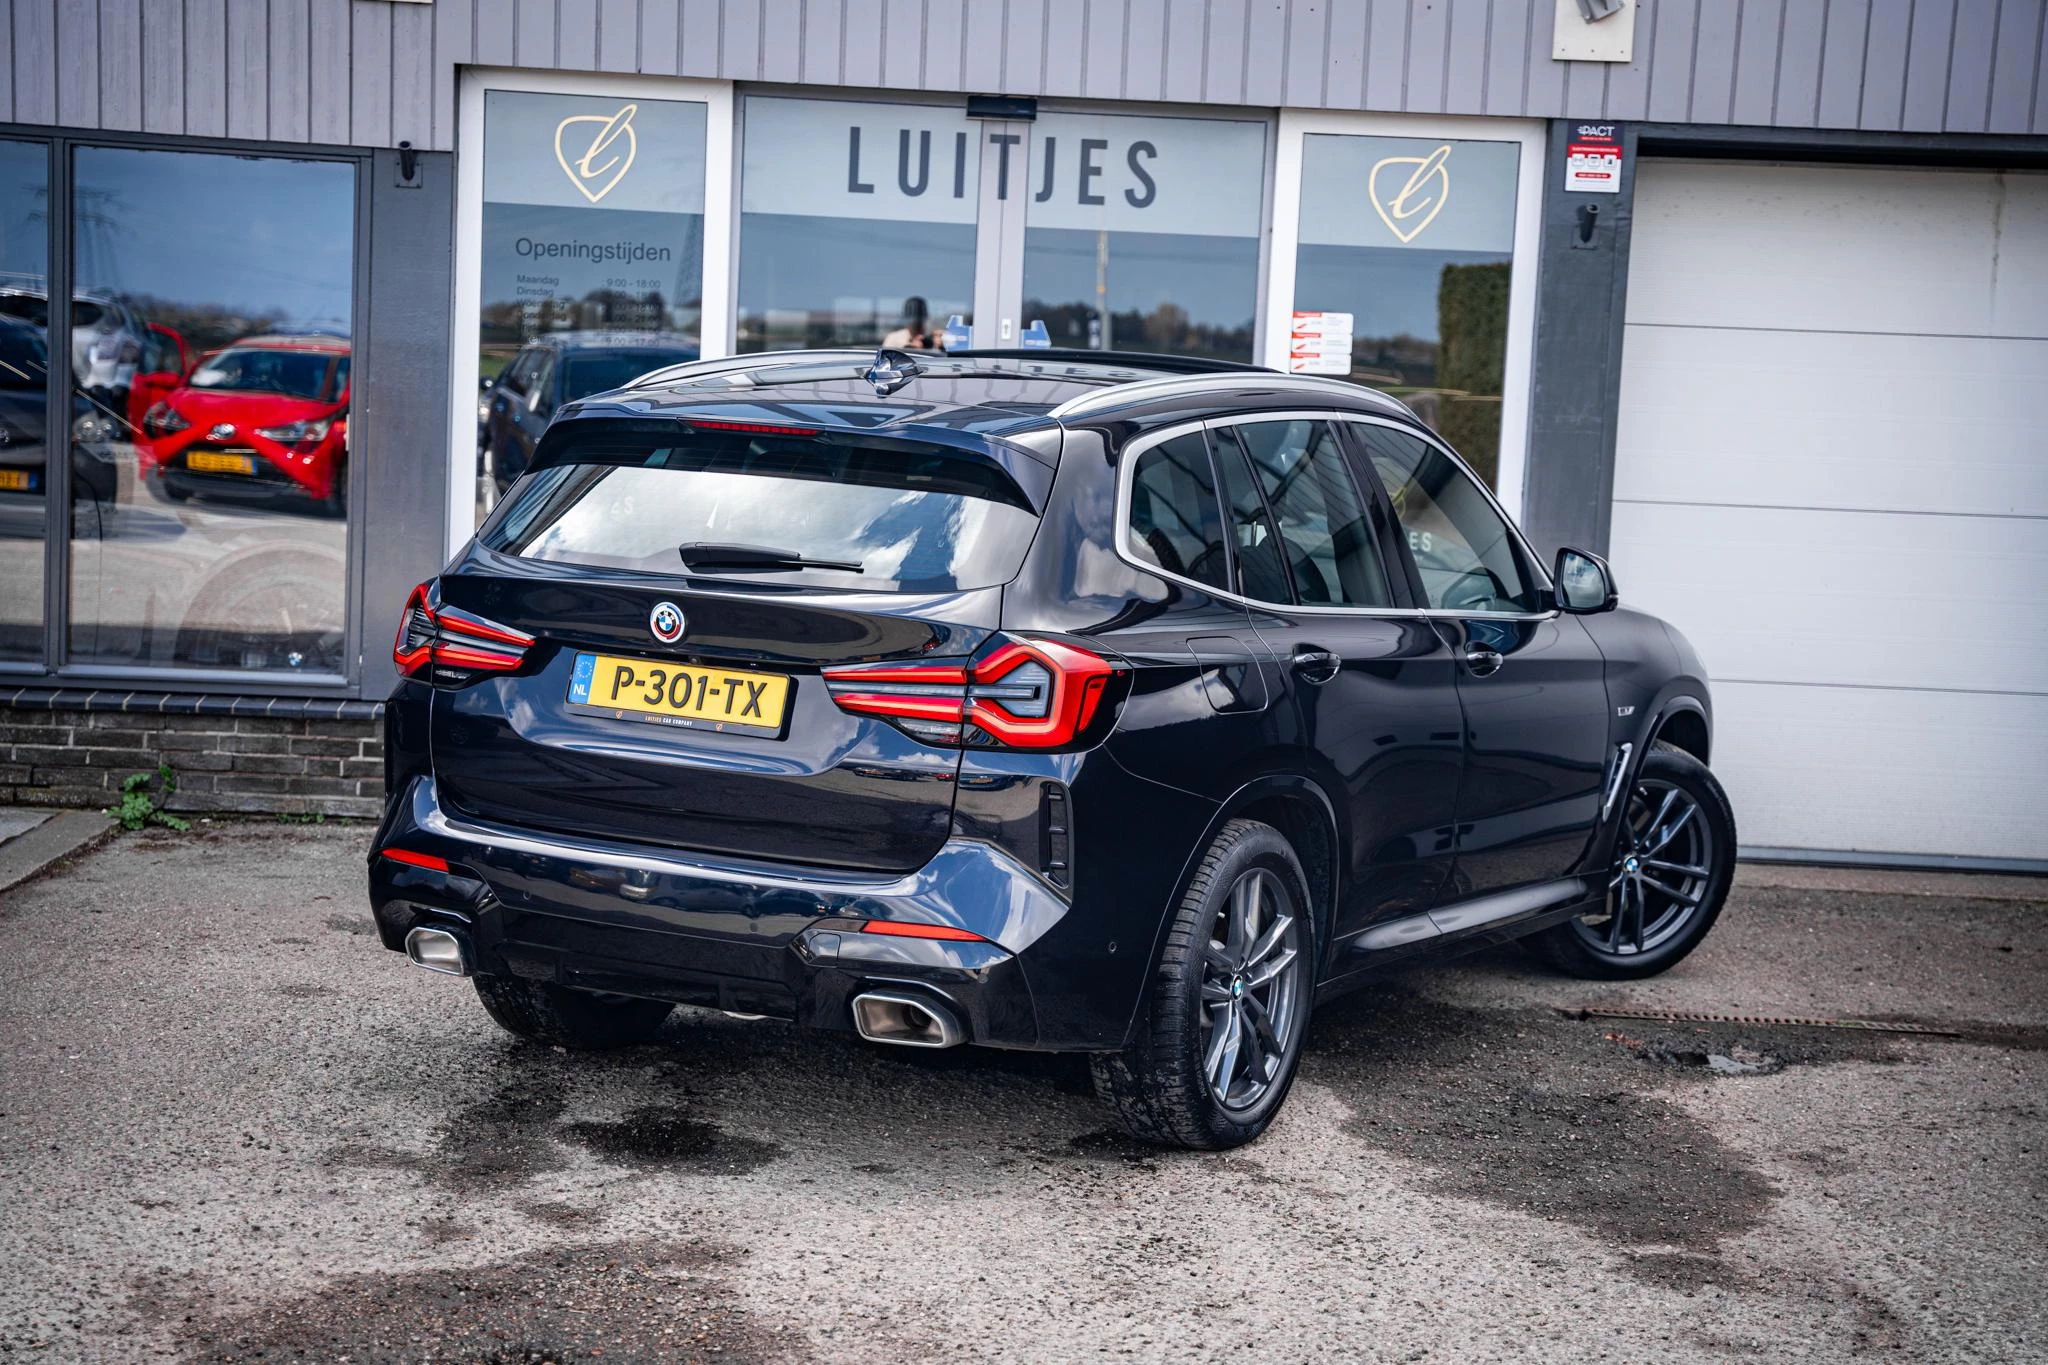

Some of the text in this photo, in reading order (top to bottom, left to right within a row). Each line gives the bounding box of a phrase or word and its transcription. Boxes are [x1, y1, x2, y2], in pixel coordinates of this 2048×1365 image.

[848, 126, 1158, 209] LUITJES
[515, 237, 672, 265] Openingstijden
[516, 274, 560, 287] Maandag
[636, 279, 662, 289] 18:00
[516, 286, 554, 298] Dinsdag
[573, 683, 587, 696] NL
[610, 665, 768, 718] P-301-TX
